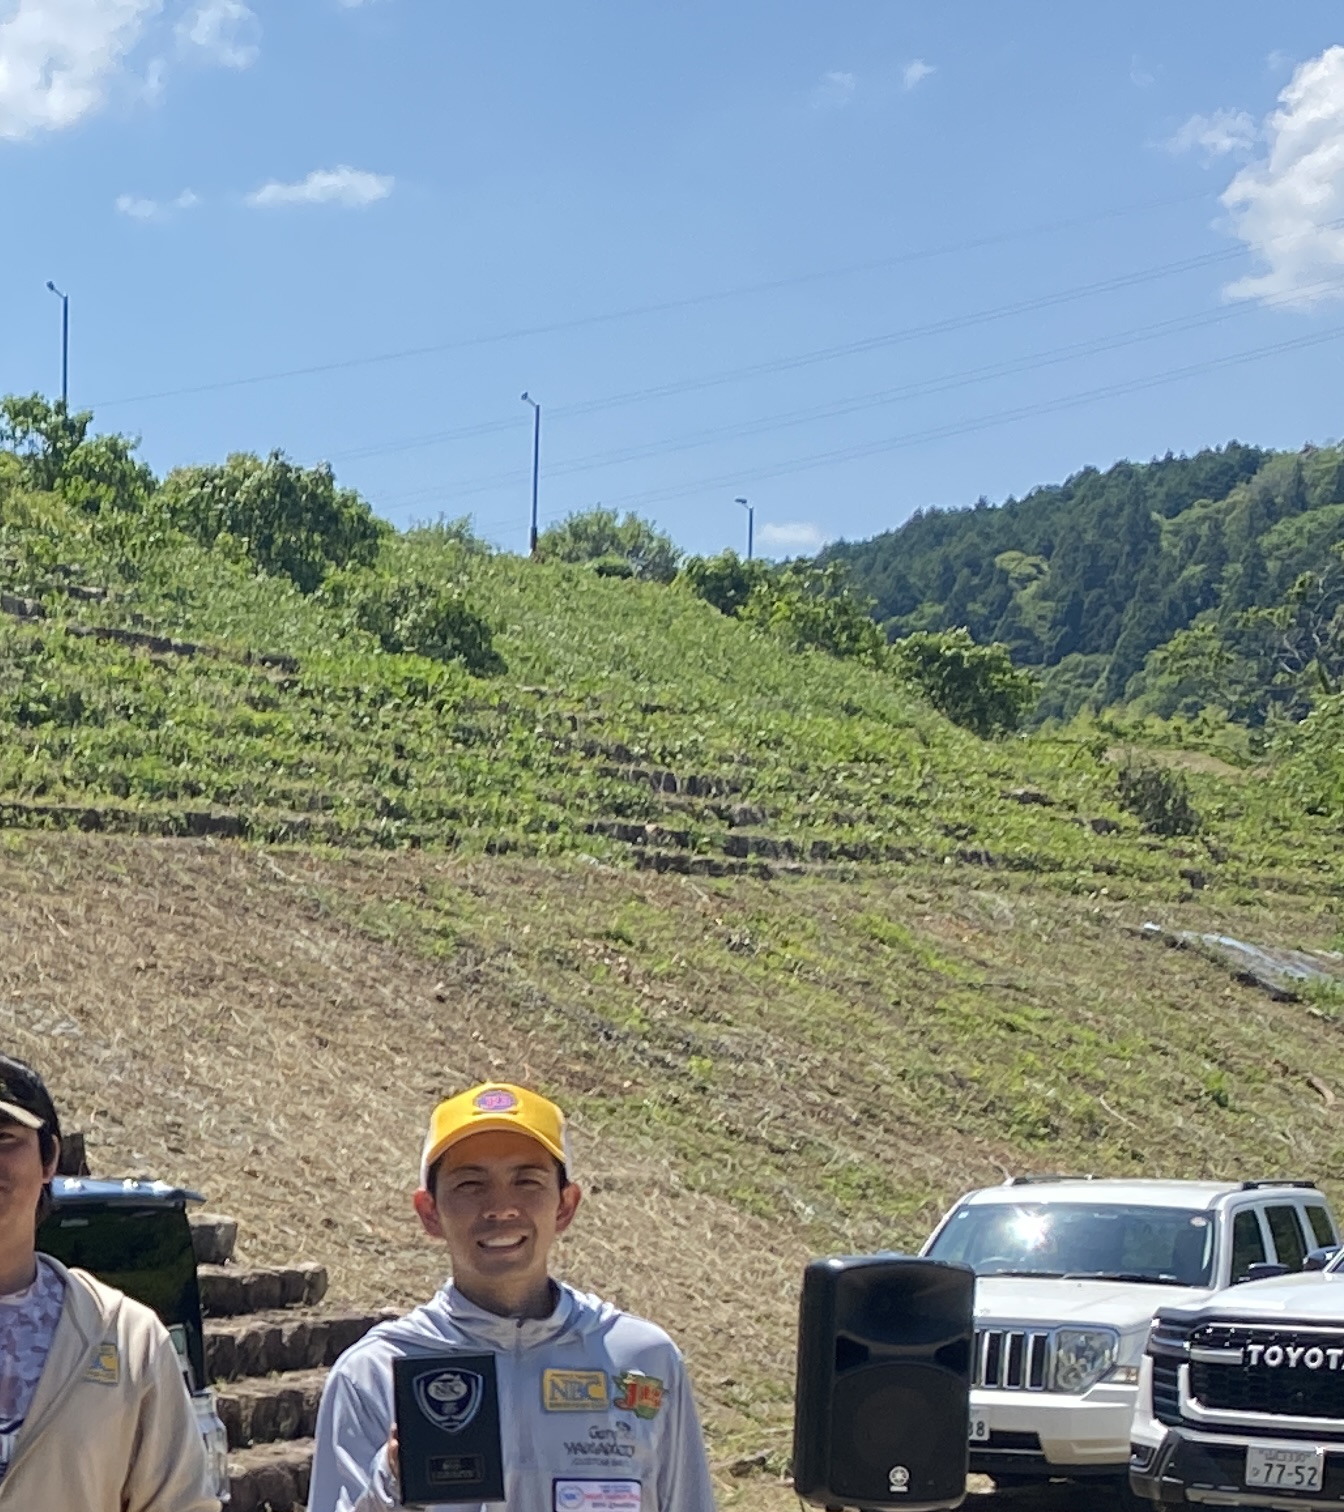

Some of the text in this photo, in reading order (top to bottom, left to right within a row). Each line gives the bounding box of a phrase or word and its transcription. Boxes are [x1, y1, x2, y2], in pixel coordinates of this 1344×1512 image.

[1247, 1344, 1344, 1371] TOYOT
[549, 1378, 603, 1402] NBC
[1263, 1462, 1318, 1487] 77-52
